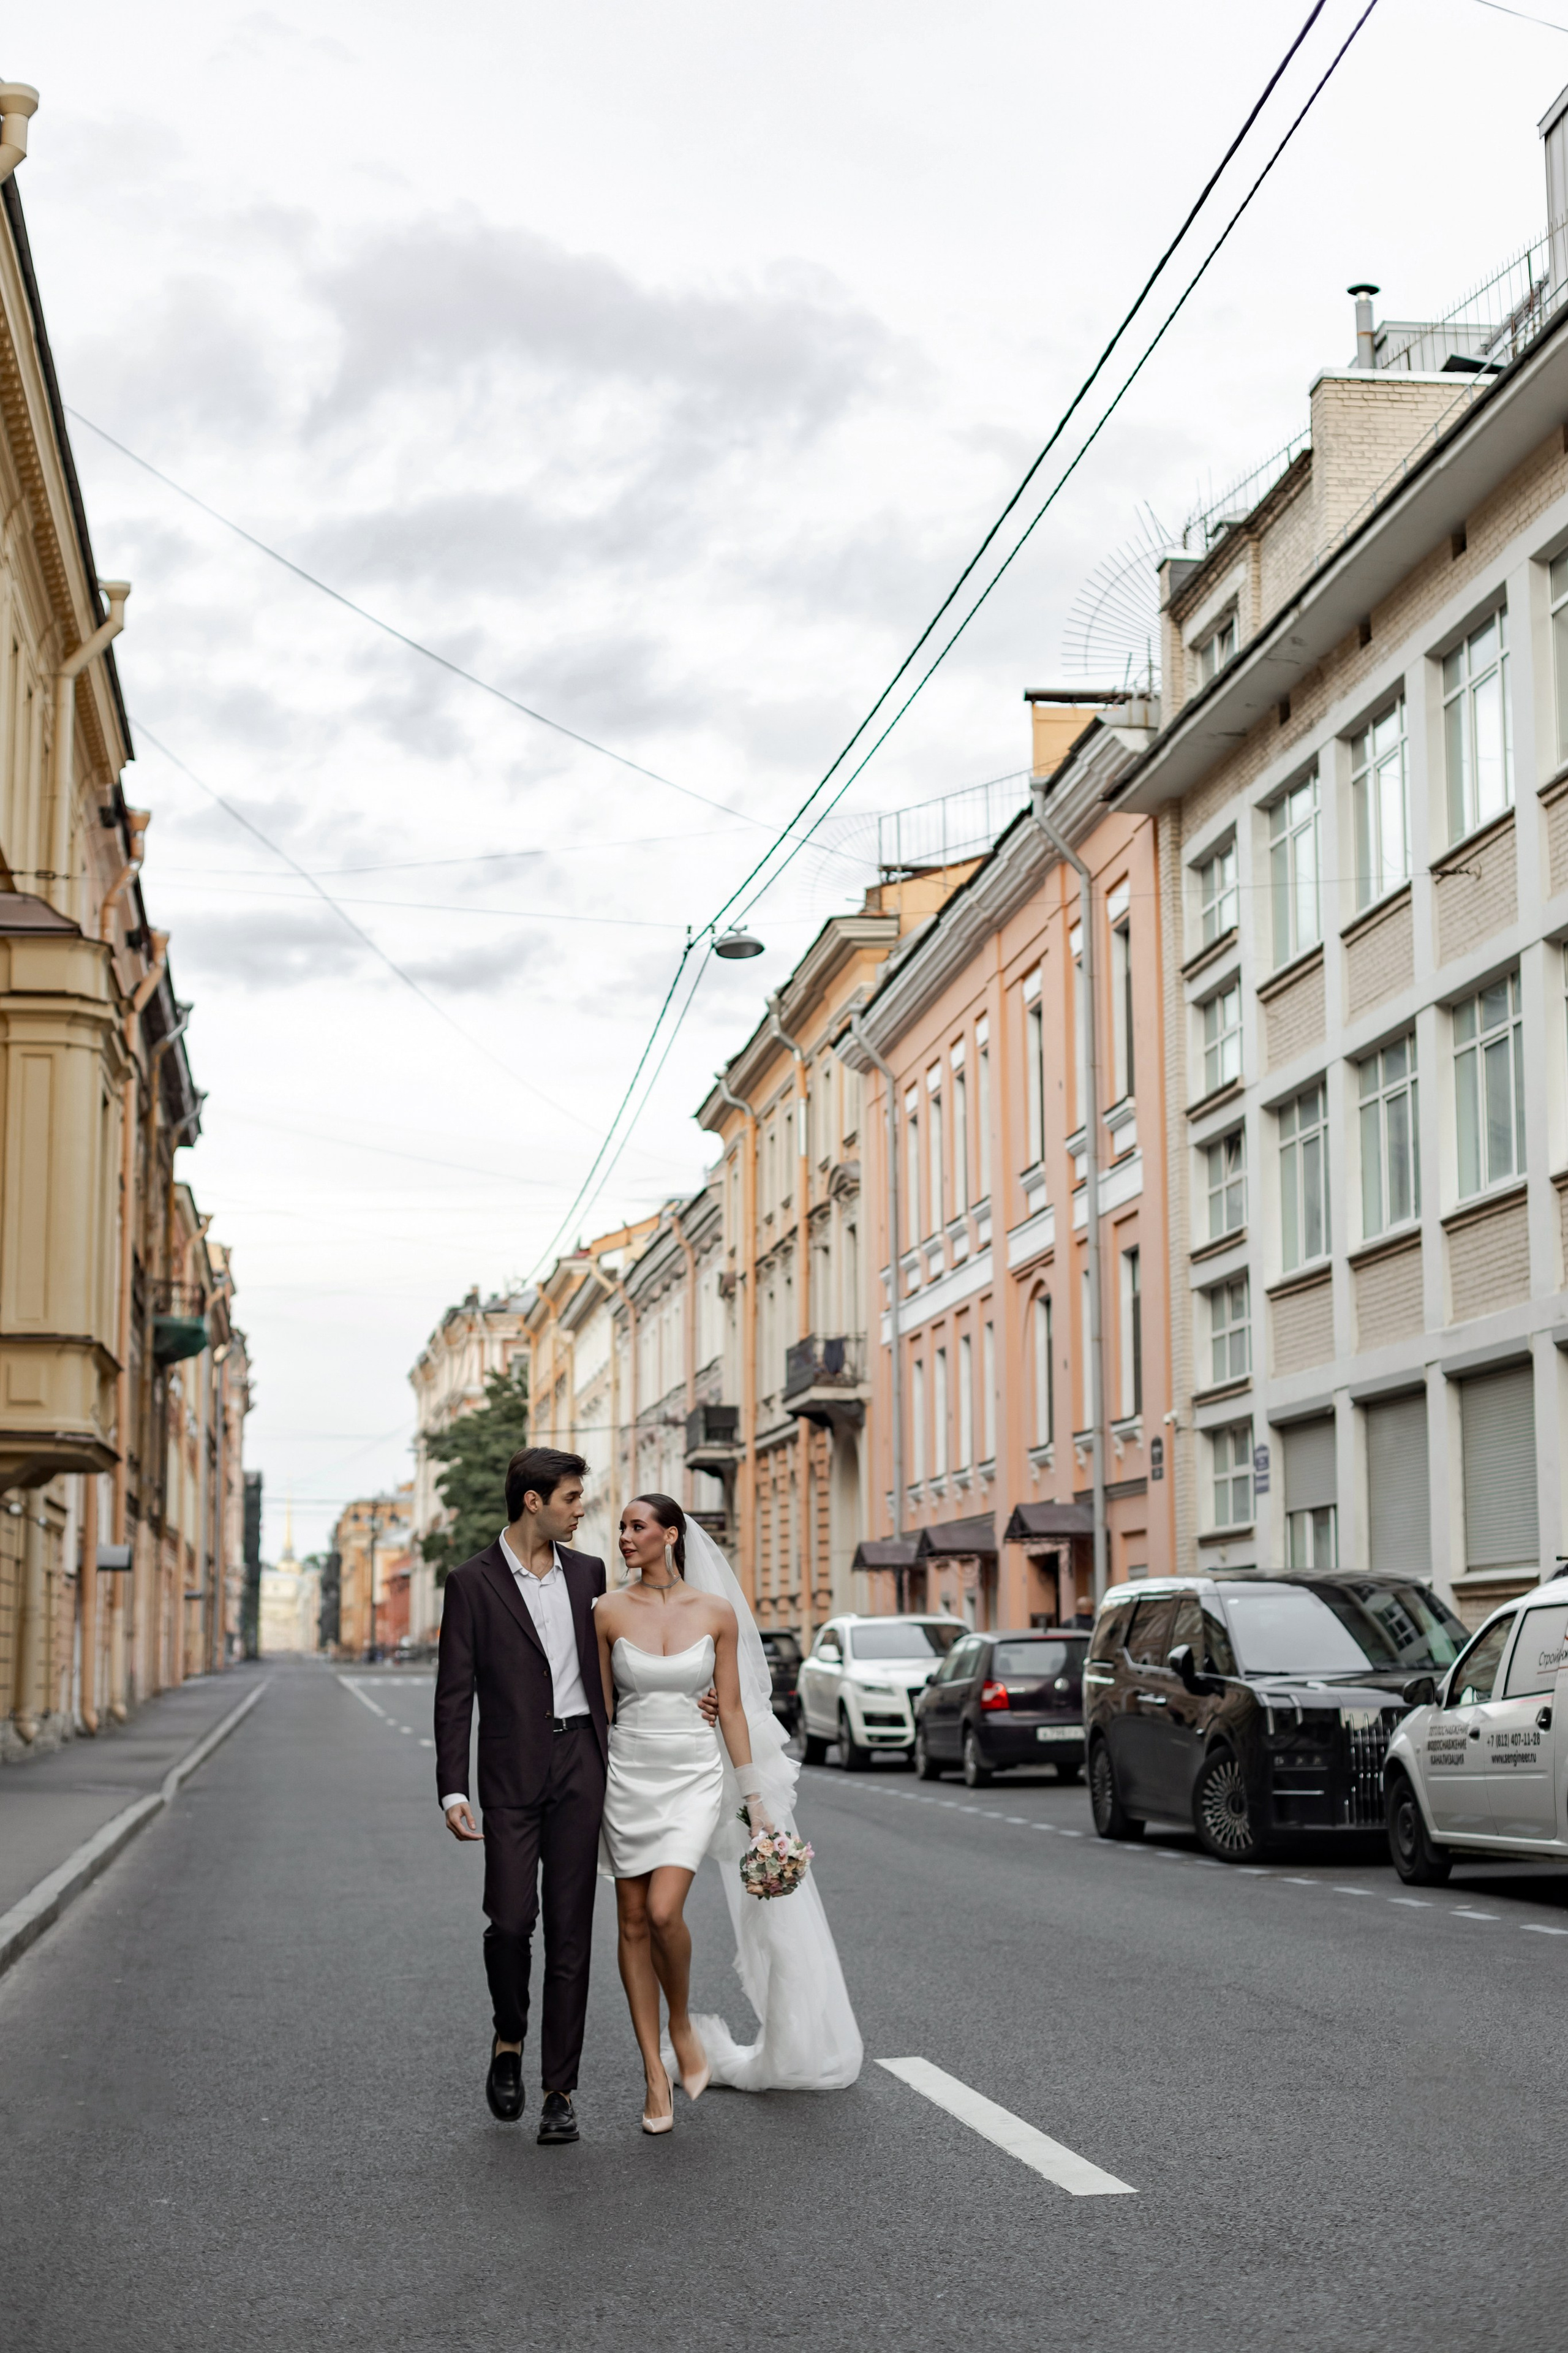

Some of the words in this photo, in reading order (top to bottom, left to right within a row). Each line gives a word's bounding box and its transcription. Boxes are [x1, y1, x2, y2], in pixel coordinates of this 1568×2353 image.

[1428, 1738, 1467, 1751] ВОДОСНАБЖЕНИЕ
[1487, 1734, 1494, 1747] +7
[1496, 1733, 1509, 1748] (812)
[1511, 1732, 1540, 1746] 407-11-28
[1431, 1753, 1464, 1766] КАНАЛИЗАЦИЯ
[1491, 1749, 1537, 1767] www.sengineer.ru
